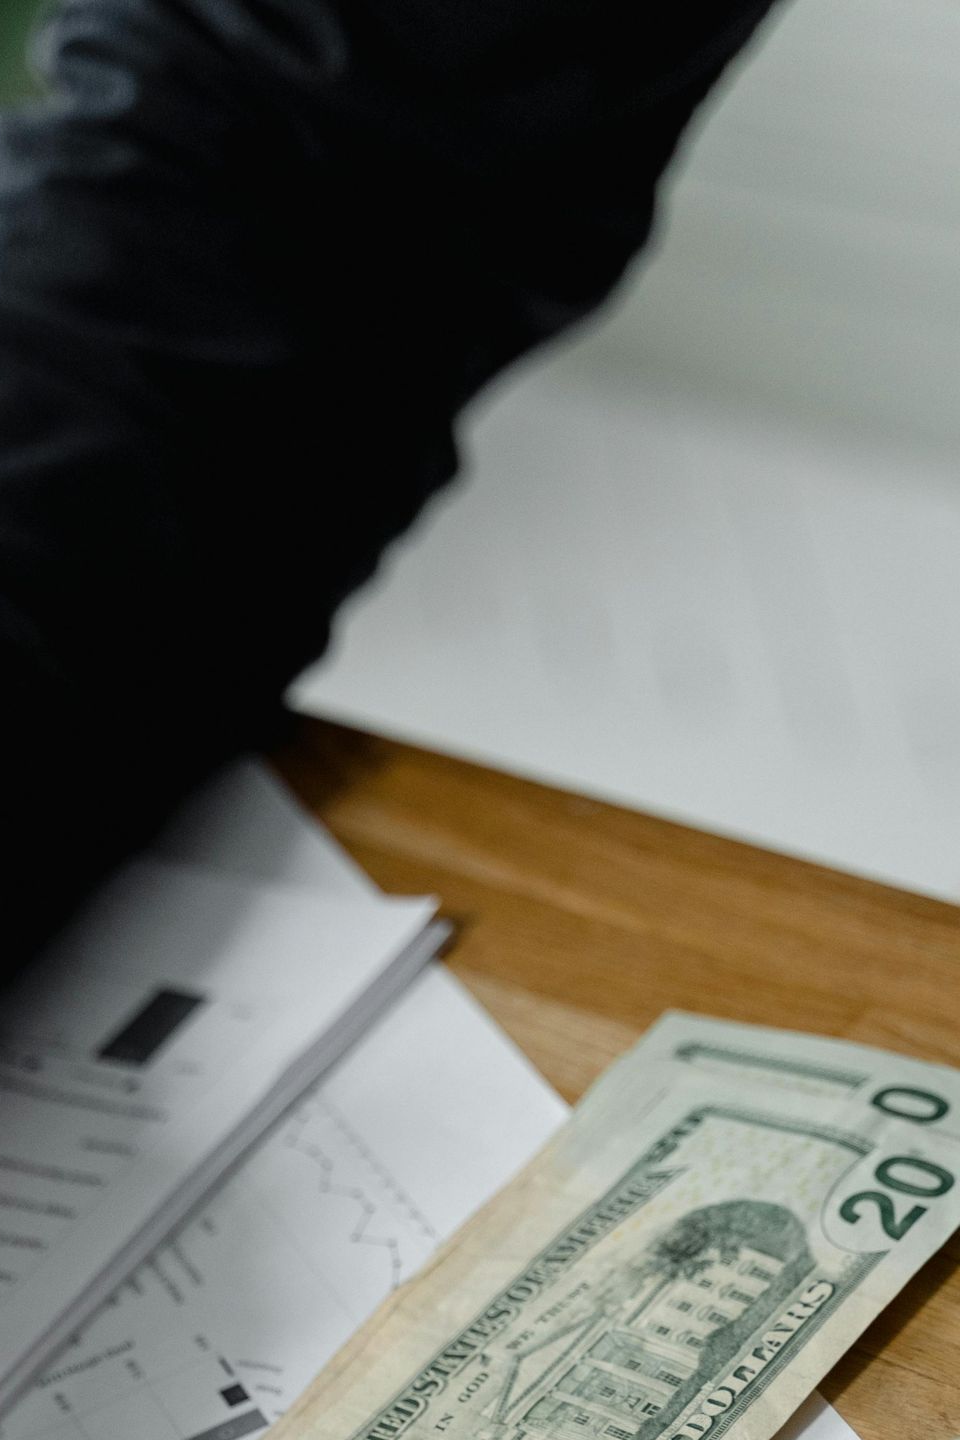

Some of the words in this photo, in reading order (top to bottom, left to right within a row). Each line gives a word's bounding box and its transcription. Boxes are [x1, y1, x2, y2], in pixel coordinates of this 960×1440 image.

[839, 1156, 955, 1241] 20
[412, 1301, 513, 1398] STATES
[507, 1270, 547, 1304] OF
[435, 1413, 454, 1431] IN
[458, 1372, 489, 1403] GOD
